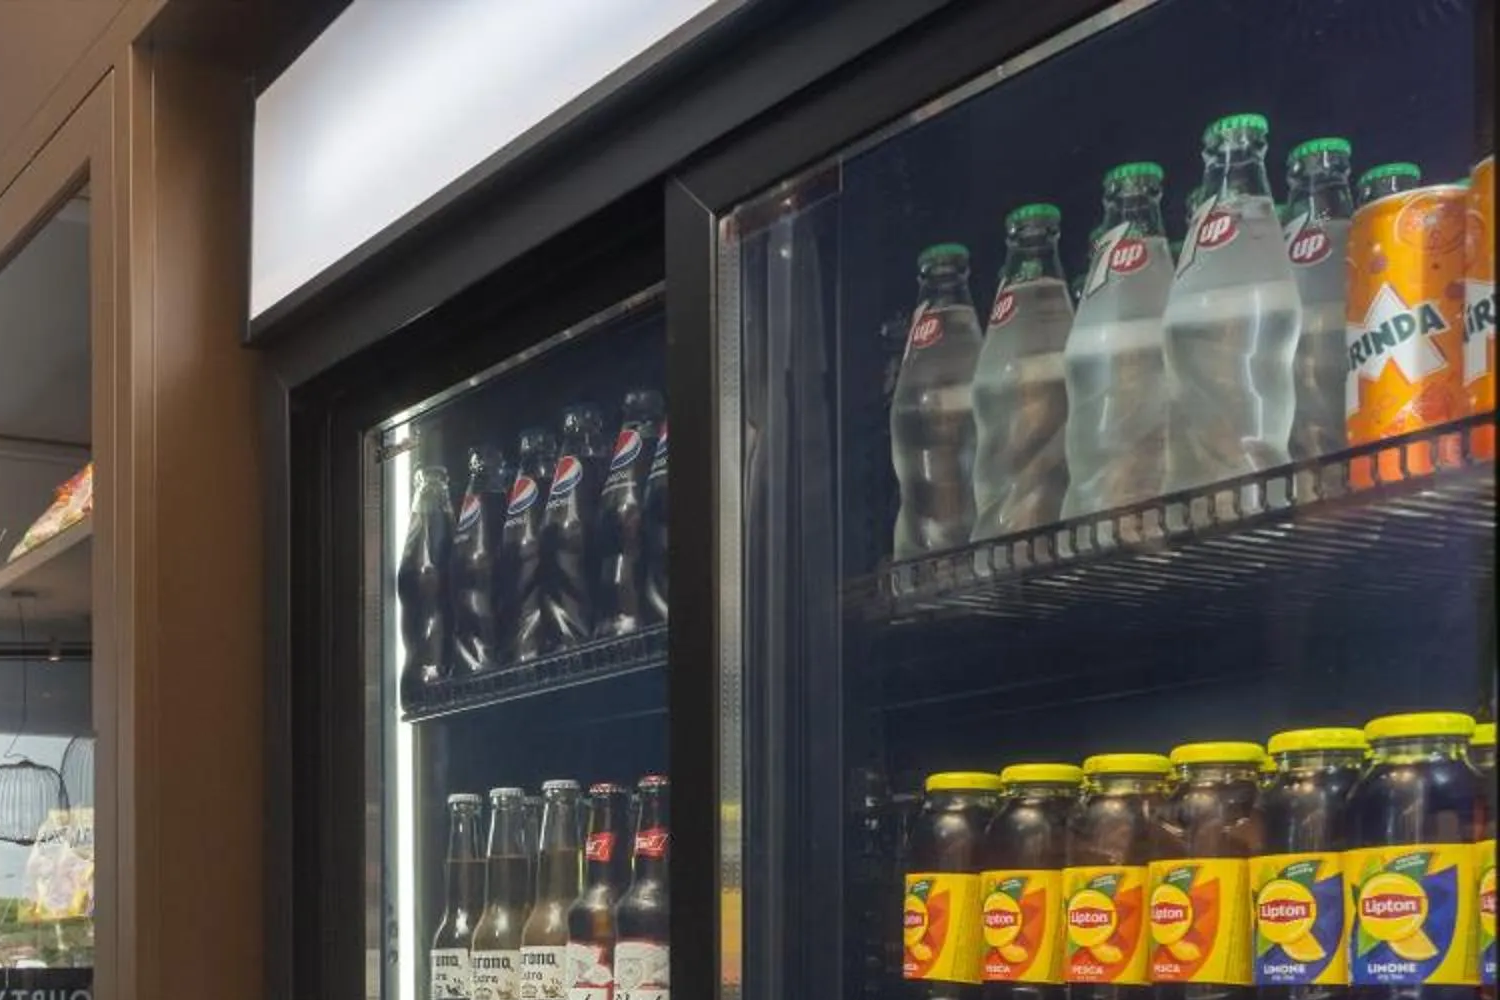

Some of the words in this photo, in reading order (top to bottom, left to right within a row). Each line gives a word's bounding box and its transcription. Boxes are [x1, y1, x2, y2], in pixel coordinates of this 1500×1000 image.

[1347, 303, 1446, 371] RINDA
[1260, 903, 1306, 921] Lipton
[1364, 899, 1417, 916] Lipton
[1070, 911, 1108, 925] Lipton
[474, 956, 514, 971] rona
[522, 952, 559, 967] rona
[1072, 964, 1104, 975] PESCA
[1263, 963, 1306, 975] LIMONE
[1367, 963, 1417, 975] LIMONE
